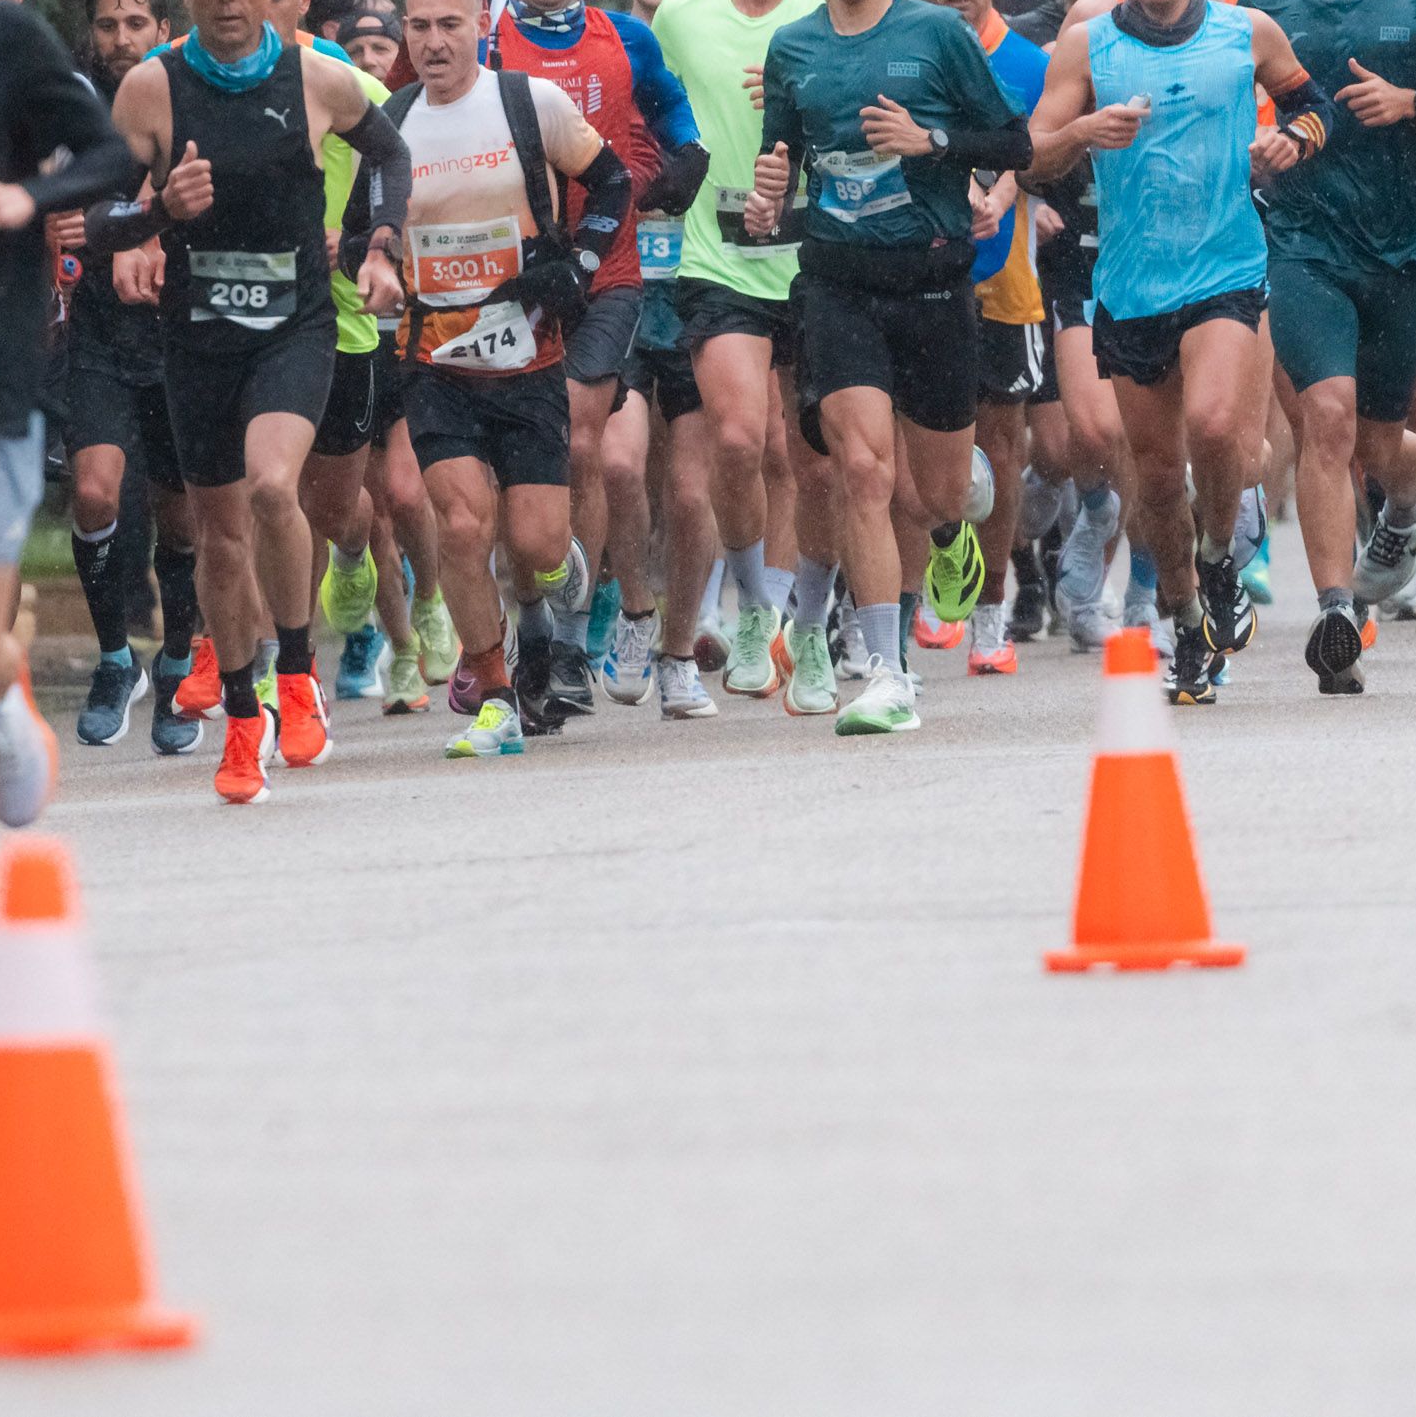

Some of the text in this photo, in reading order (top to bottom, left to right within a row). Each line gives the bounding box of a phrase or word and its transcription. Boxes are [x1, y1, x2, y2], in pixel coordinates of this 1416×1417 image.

[409, 148, 510, 180] unningzgz
[432, 259, 479, 281] 3:00
[209, 282, 269, 309] 208
[450, 326, 517, 358] 2174
